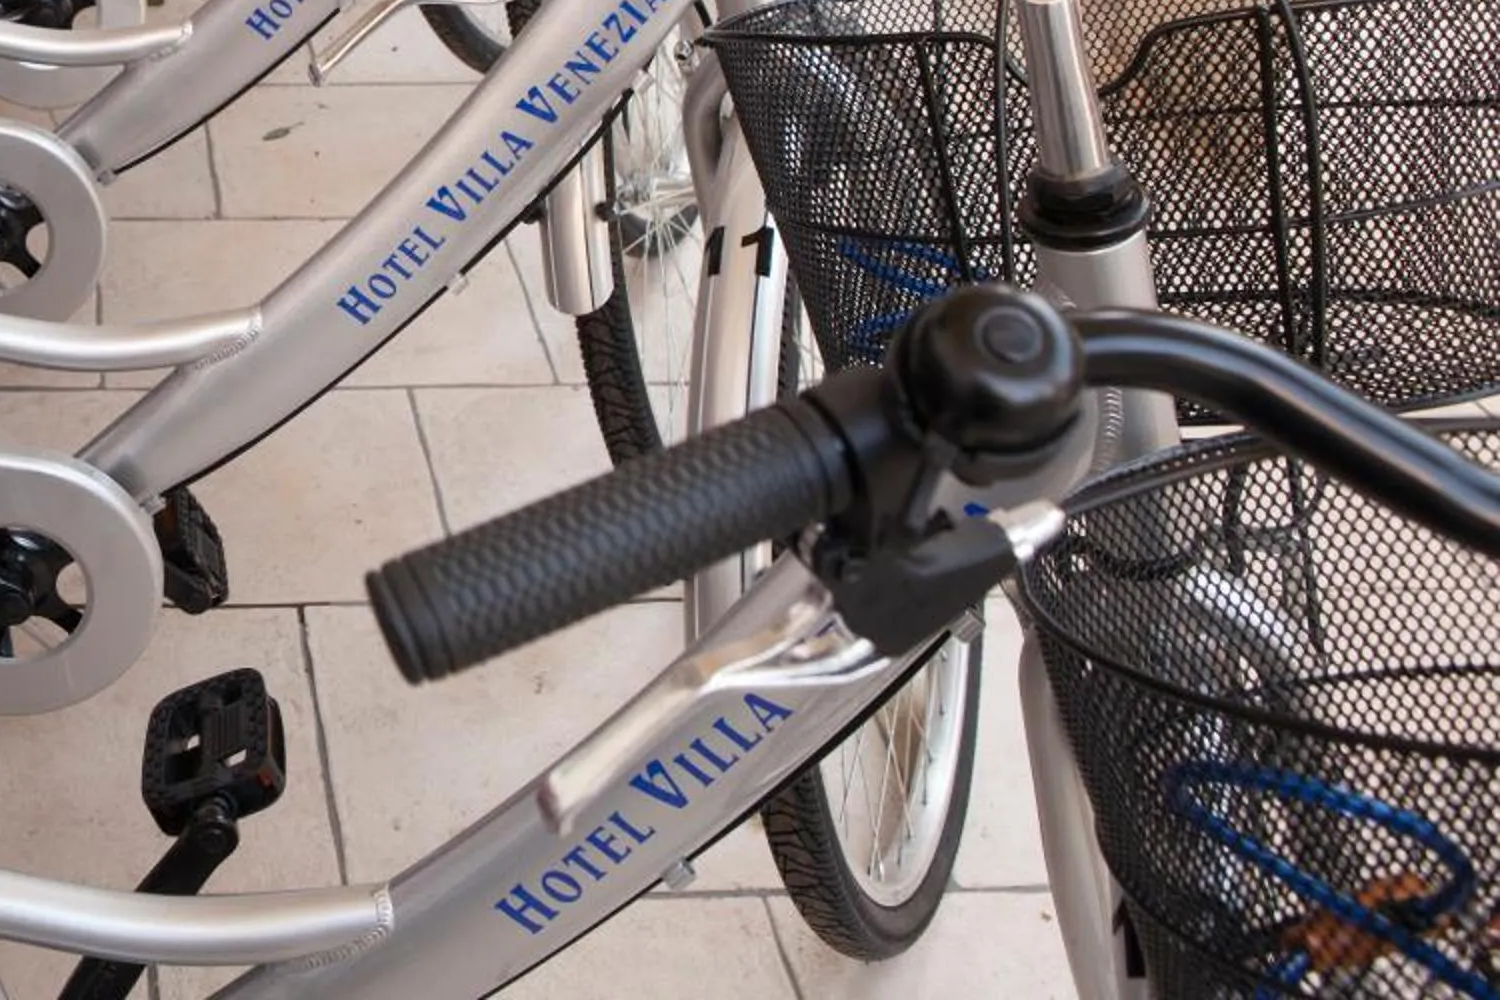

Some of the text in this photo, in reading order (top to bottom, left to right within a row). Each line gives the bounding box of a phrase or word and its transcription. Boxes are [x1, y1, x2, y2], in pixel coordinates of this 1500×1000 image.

[335, 225, 448, 326] HOTEL
[425, 129, 535, 223] VILLA
[494, 691, 794, 935] HOTEL VILLA
